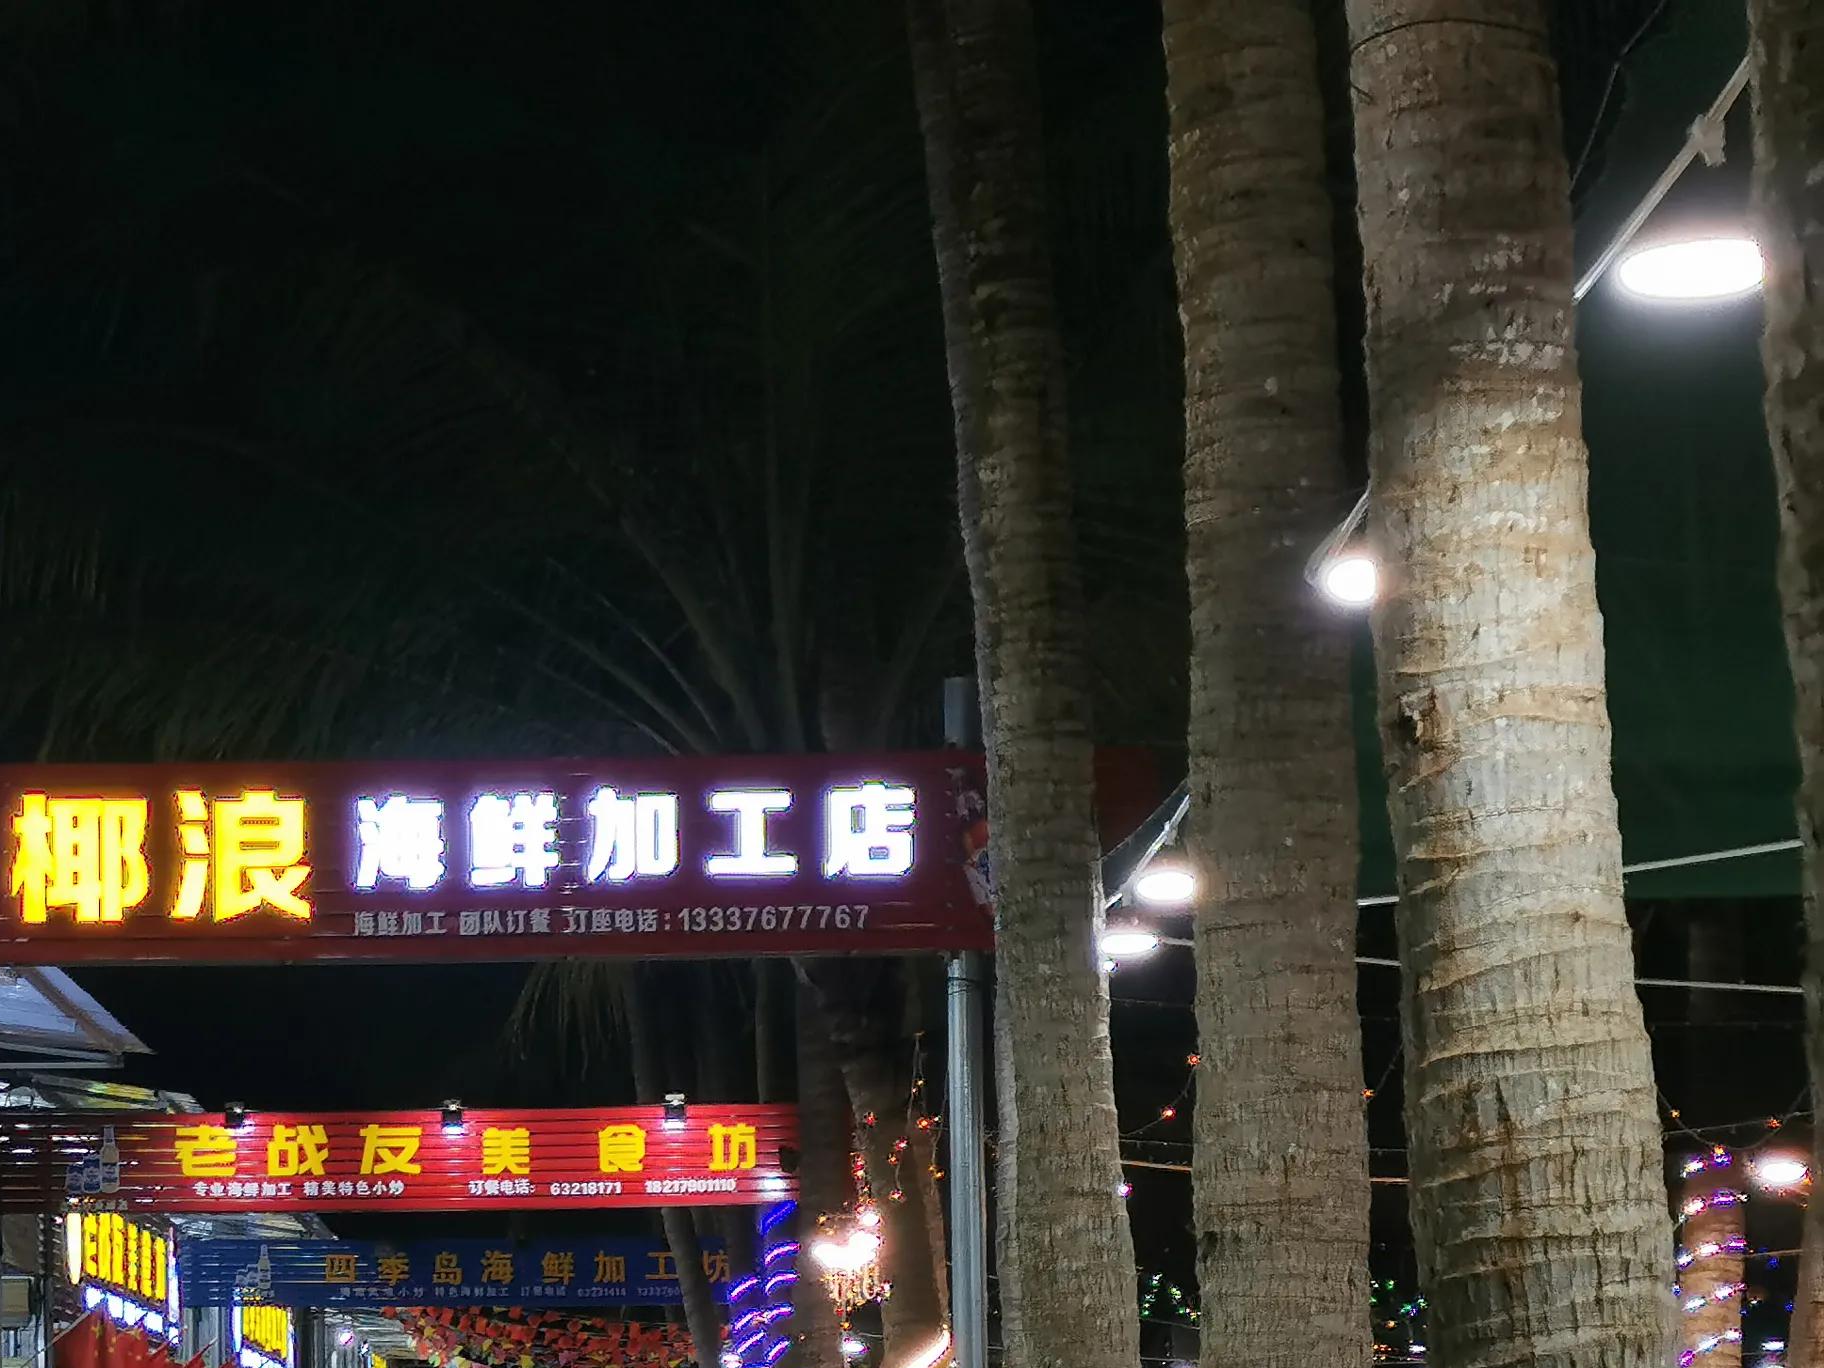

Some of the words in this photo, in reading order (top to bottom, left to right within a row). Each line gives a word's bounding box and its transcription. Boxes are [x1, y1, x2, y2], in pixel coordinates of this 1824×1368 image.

[9, 787, 314, 924] 椰浪
[353, 779, 919, 889] 海鲜加工店
[353, 909, 448, 937] 海鲜加工
[459, 907, 552, 936] 团队订餐
[174, 1122, 758, 1178] 老战友美食坊
[192, 1181, 293, 1198] 专业海鲜加工
[325, 1249, 732, 1287] 四季岛海鲜加工坊
